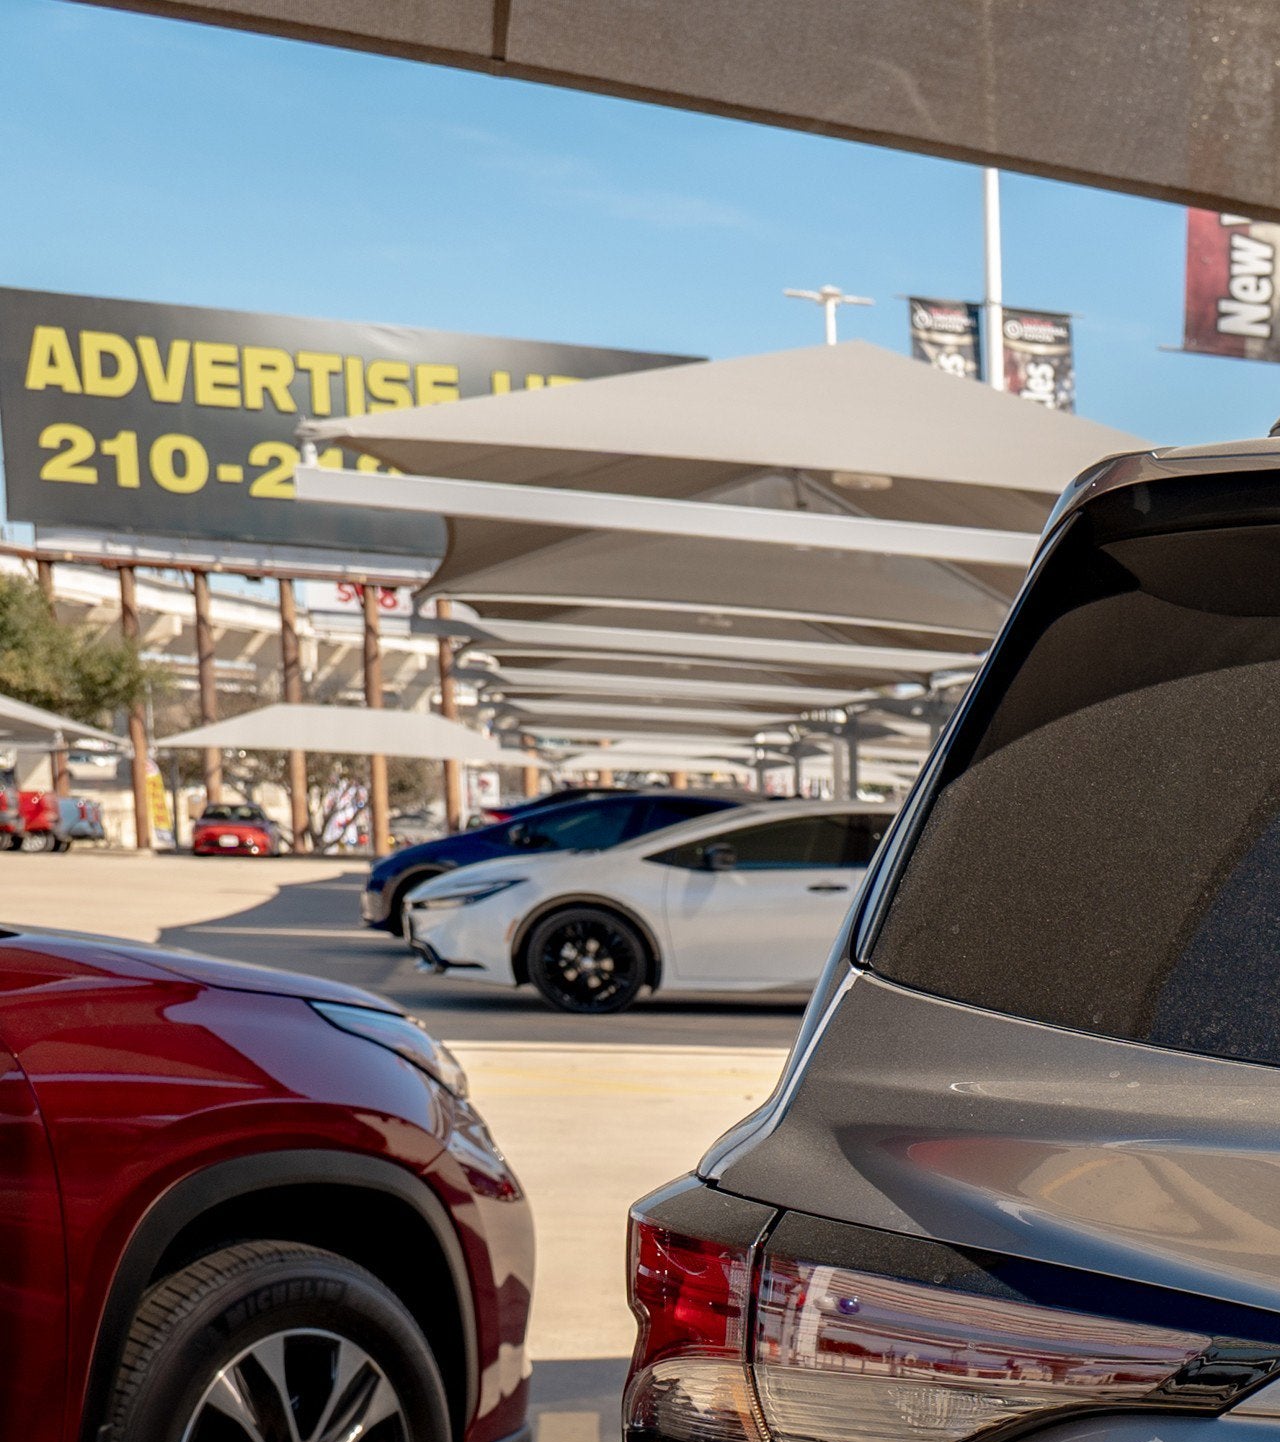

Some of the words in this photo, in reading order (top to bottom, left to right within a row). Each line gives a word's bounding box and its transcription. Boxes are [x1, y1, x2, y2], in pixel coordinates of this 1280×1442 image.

[1217, 233, 1274, 338] New
[26, 326, 460, 417] ADVERTISE
[38, 422, 402, 500] 210-2
